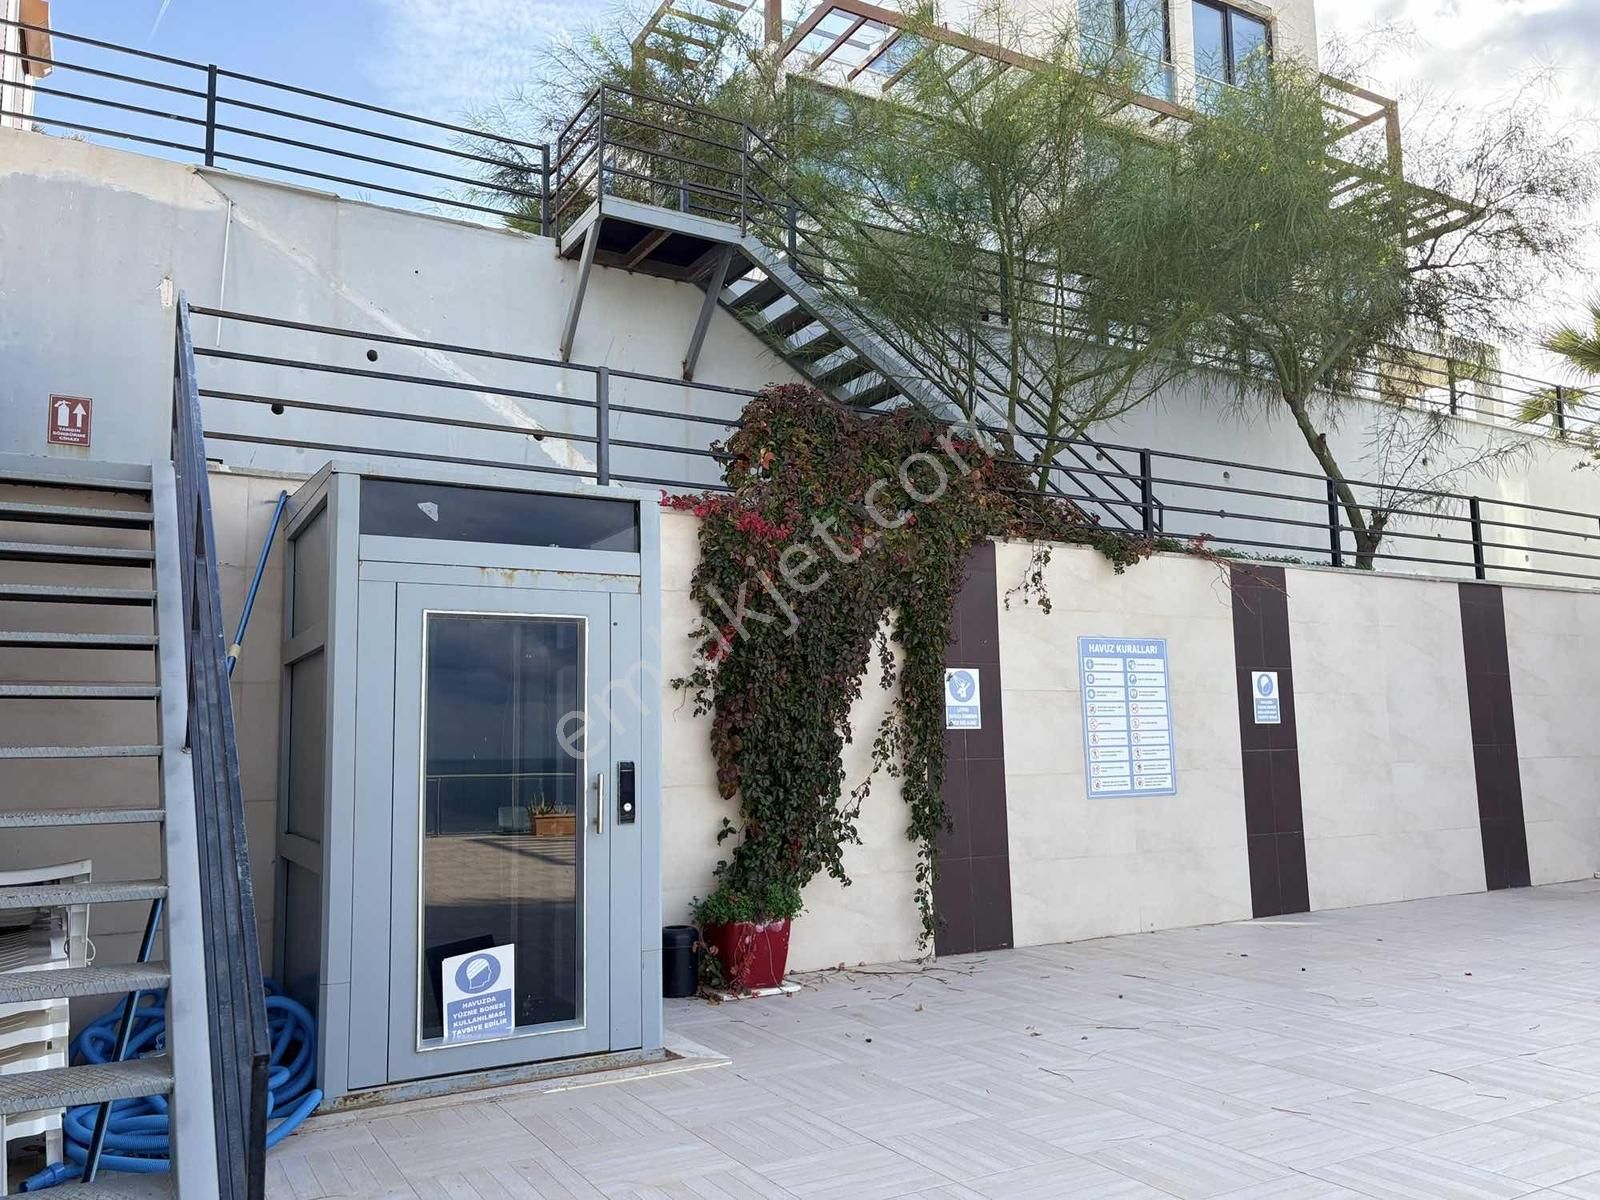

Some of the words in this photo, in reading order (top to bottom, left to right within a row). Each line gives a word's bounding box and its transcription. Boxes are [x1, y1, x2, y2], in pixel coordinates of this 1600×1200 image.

[1088, 643, 1115, 654] HAVUZ
[1116, 644, 1158, 655] KURALLARI
[462, 996, 496, 1009] HAVUZDA
[453, 1008, 478, 1020] YÜZME
[479, 1001, 506, 1012] BONESİ
[453, 1011, 506, 1027] KULLANILMASI
